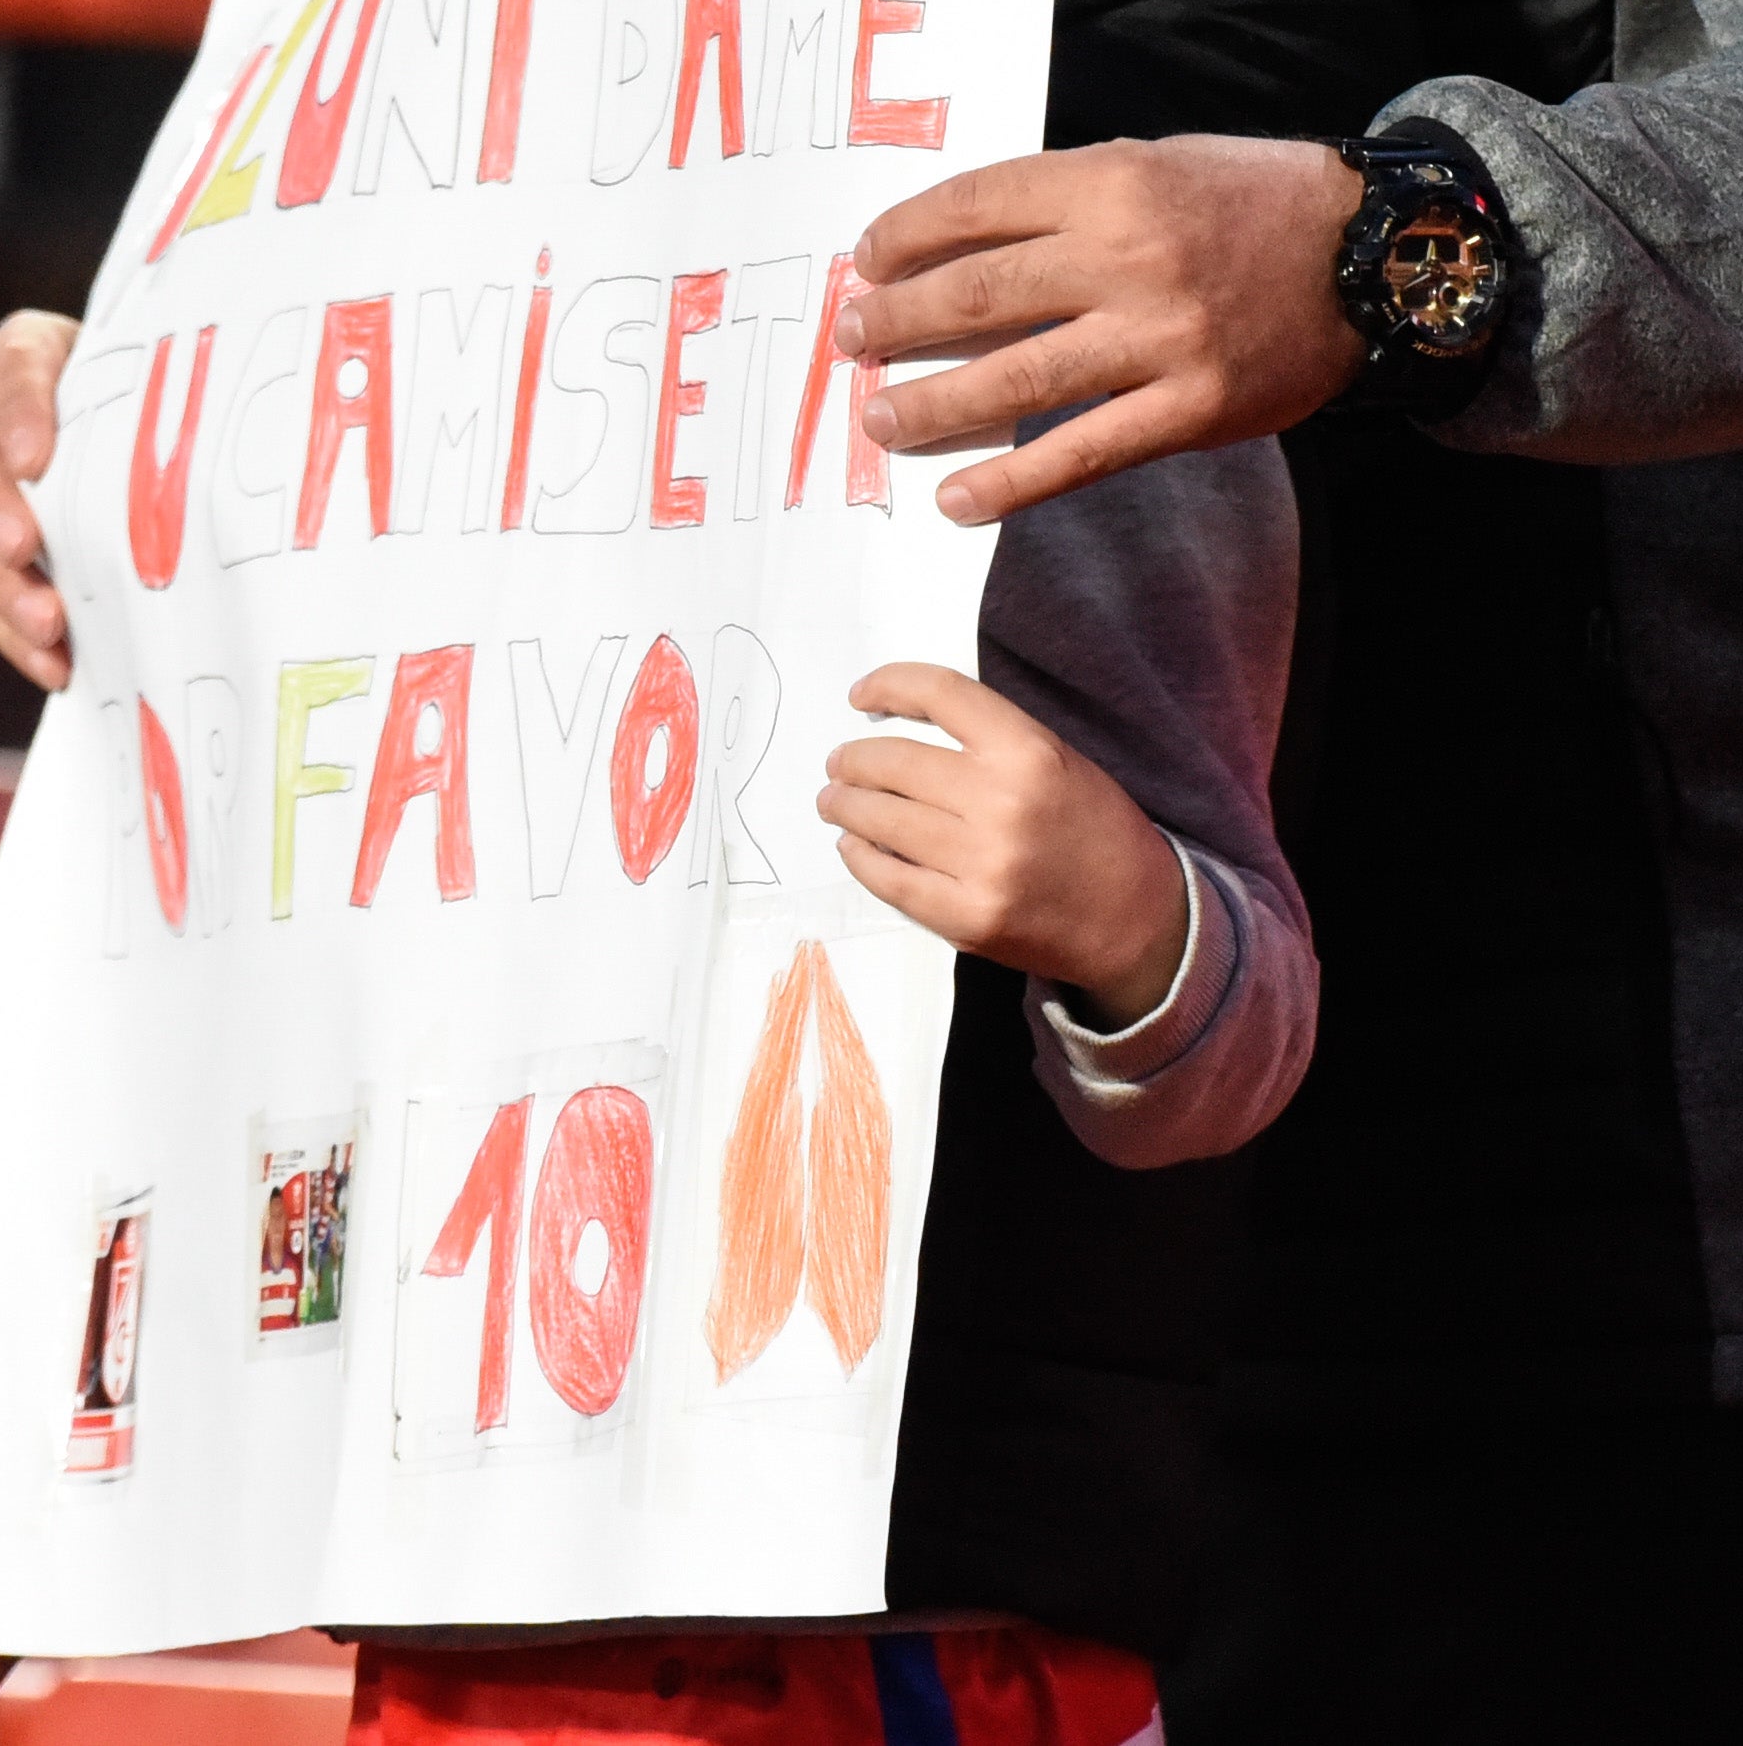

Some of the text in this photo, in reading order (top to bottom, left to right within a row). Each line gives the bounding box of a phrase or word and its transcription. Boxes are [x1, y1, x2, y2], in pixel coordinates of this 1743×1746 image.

[98, 623, 782, 960] POR FAVOR
[420, 1081, 654, 1435] 10
